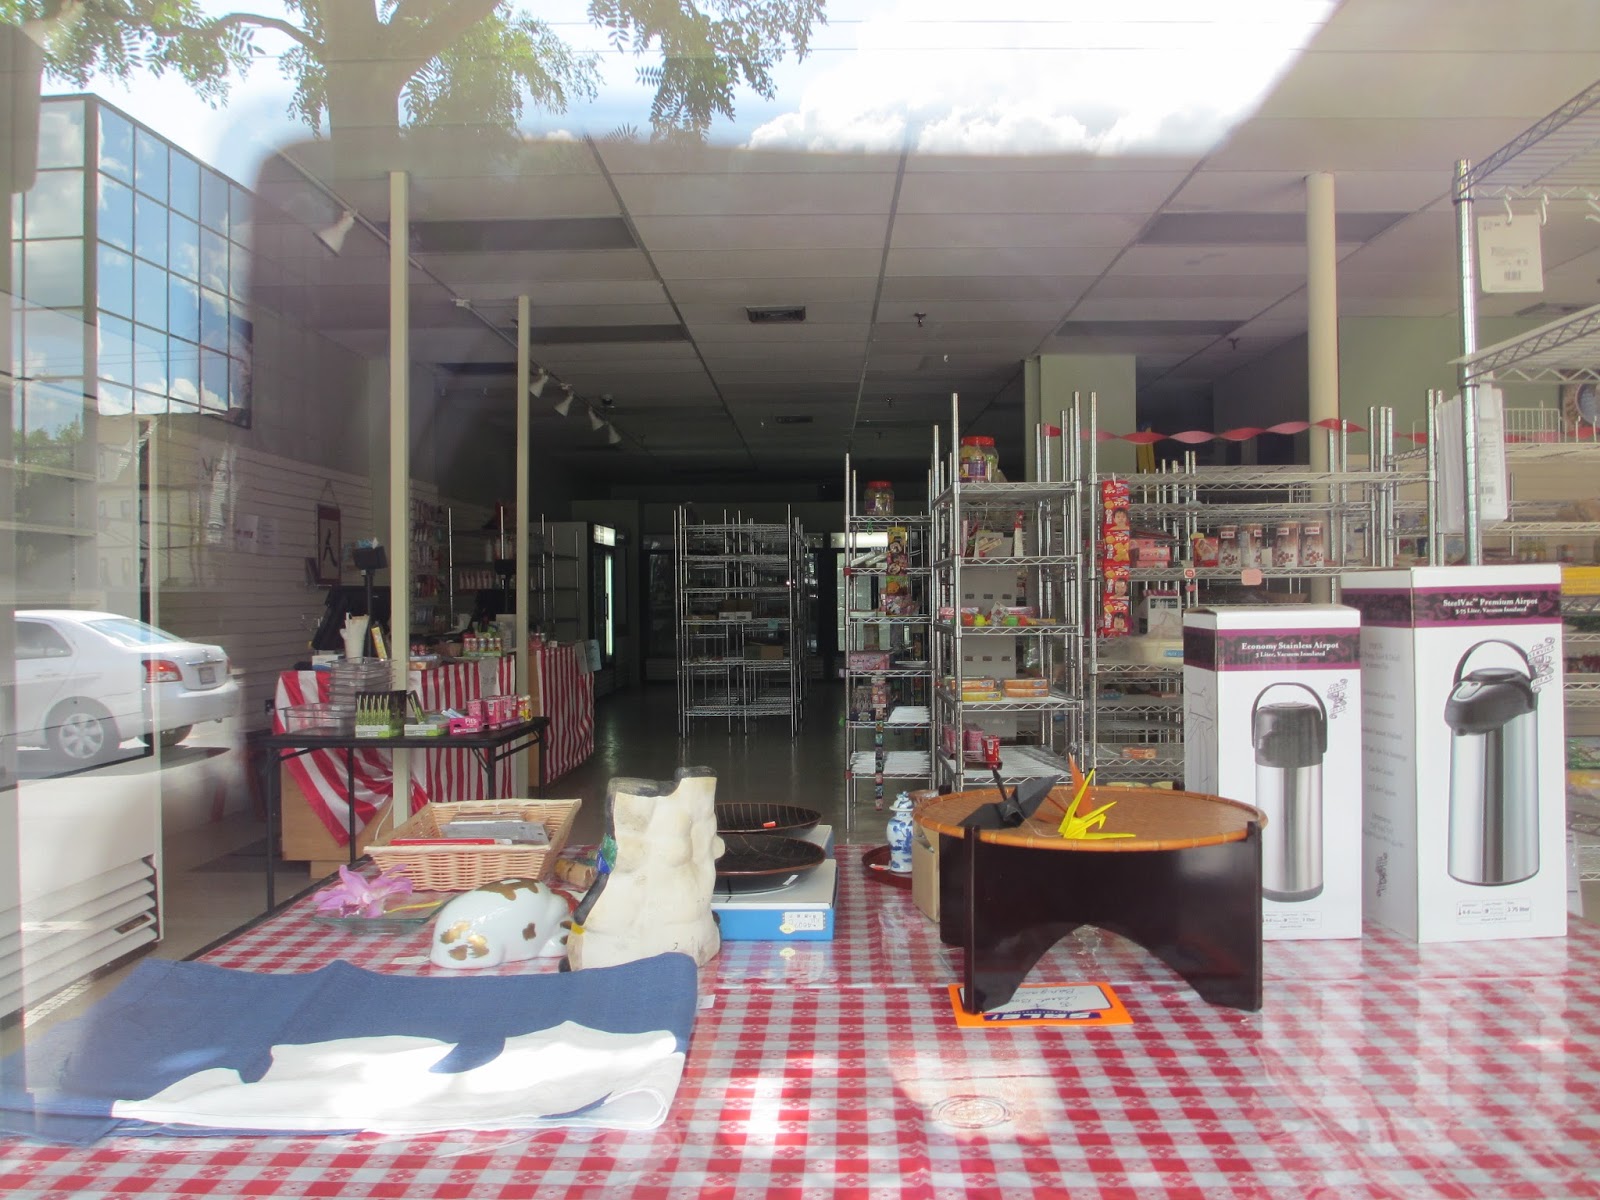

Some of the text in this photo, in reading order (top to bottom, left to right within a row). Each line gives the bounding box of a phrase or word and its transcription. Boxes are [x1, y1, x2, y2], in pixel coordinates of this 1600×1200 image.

[1480, 598, 1514, 606] Premium
[1514, 597, 1538, 606] Airpot
[1241, 642, 1277, 652] Economy
[1313, 641, 1339, 650] Airpot
